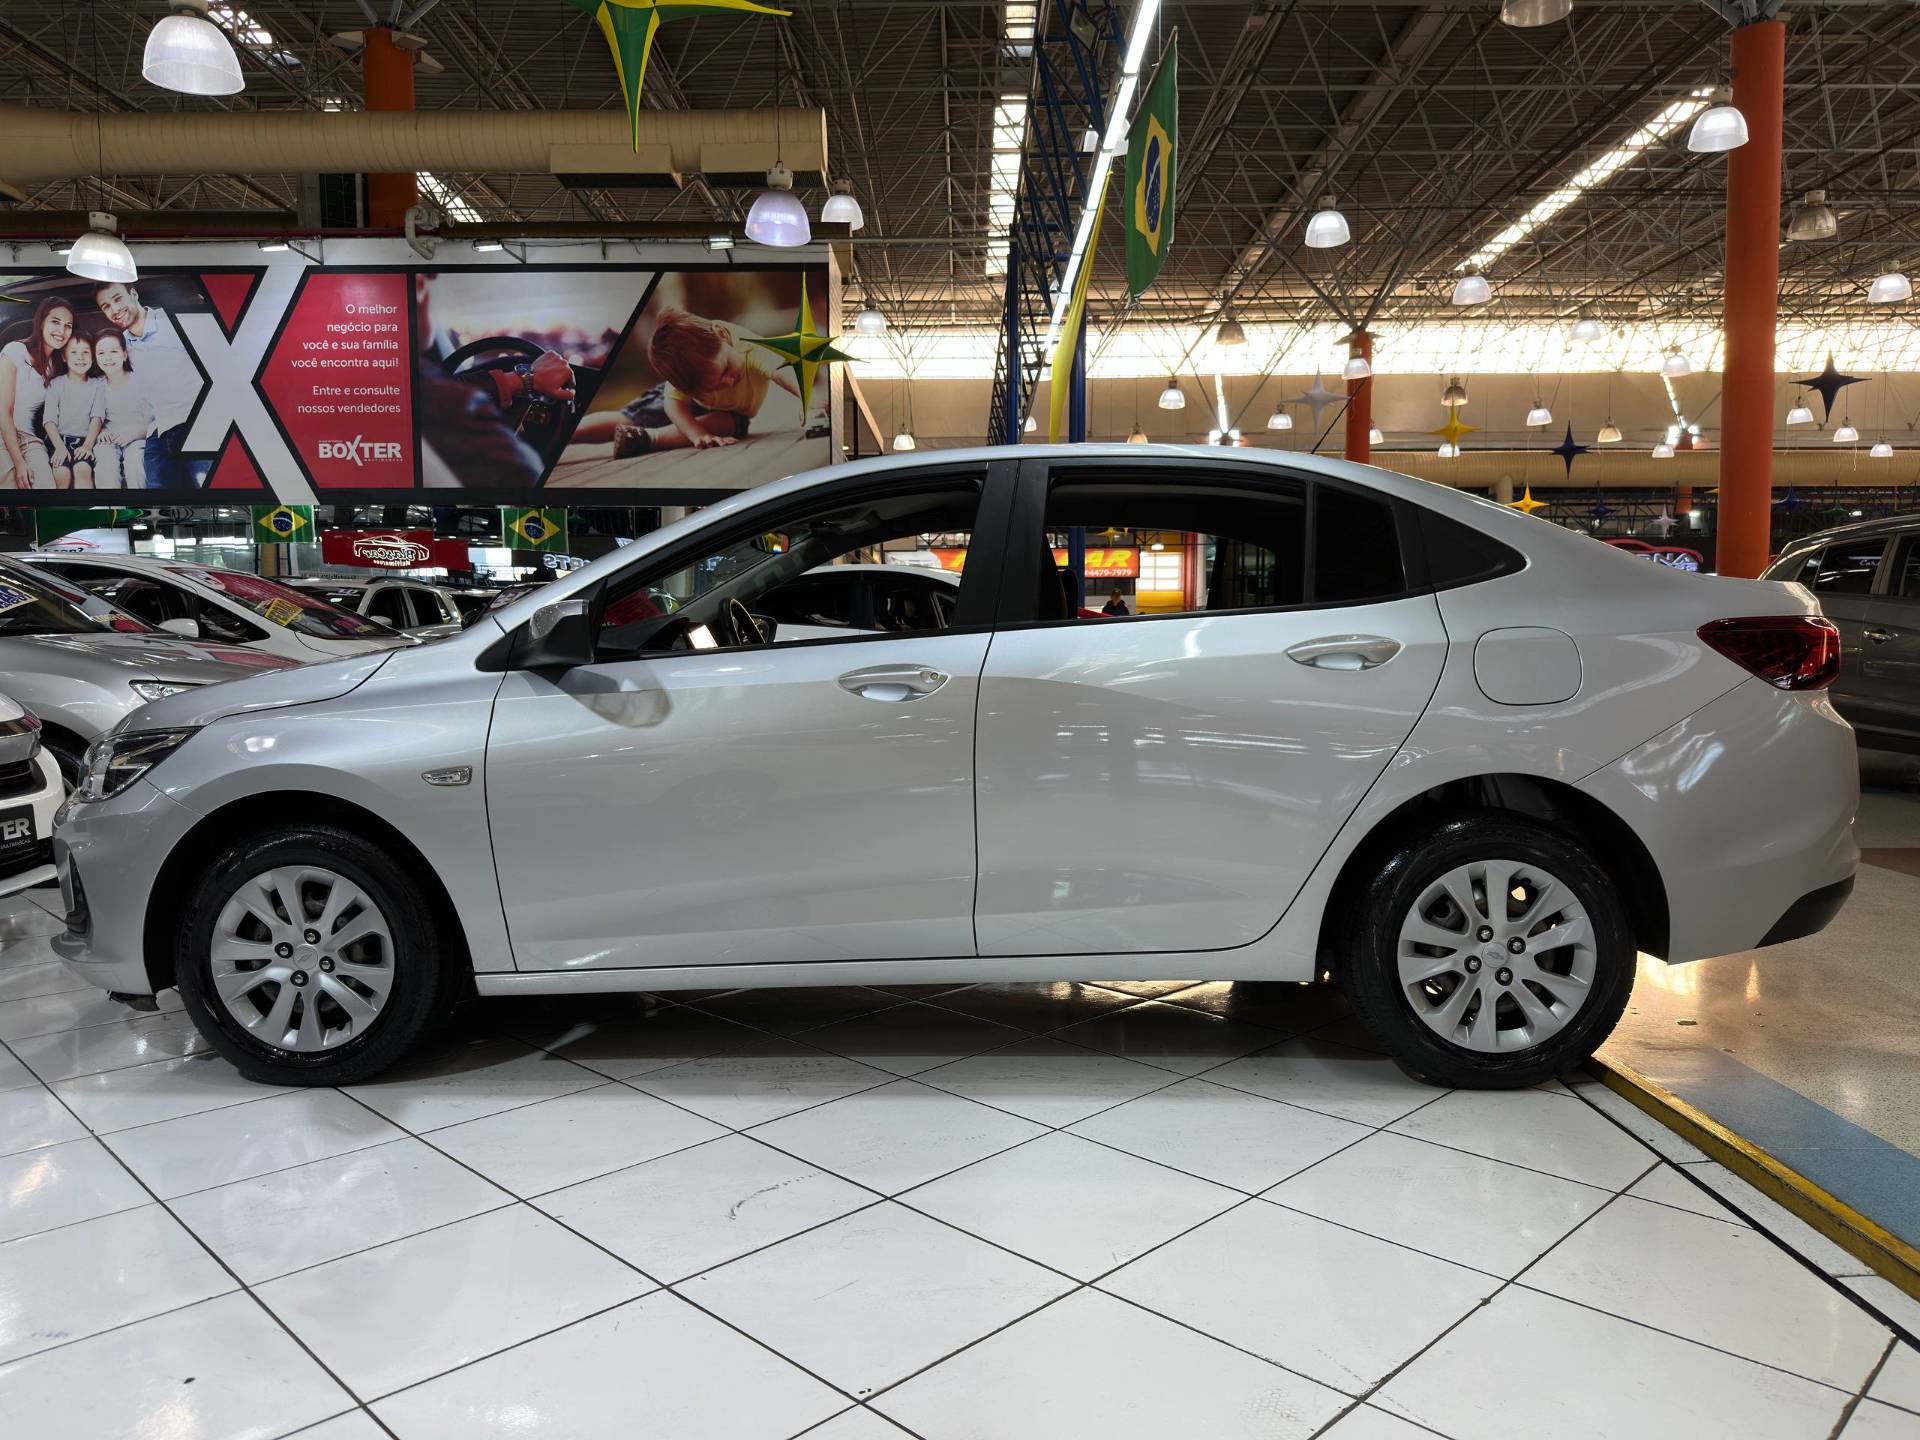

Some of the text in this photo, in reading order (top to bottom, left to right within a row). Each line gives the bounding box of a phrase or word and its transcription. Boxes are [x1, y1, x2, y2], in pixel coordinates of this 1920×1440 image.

[346, 304, 398, 314] O melhor
[327, 322, 398, 335] negócio para
[302, 340, 329, 350] você
[362, 340, 399, 350] família
[291, 357, 399, 370] você encontra aqui!
[312, 385, 401, 396] Entre e consulte
[297, 403, 401, 414] nossos vendedores
[318, 435, 402, 467] BOXTER
